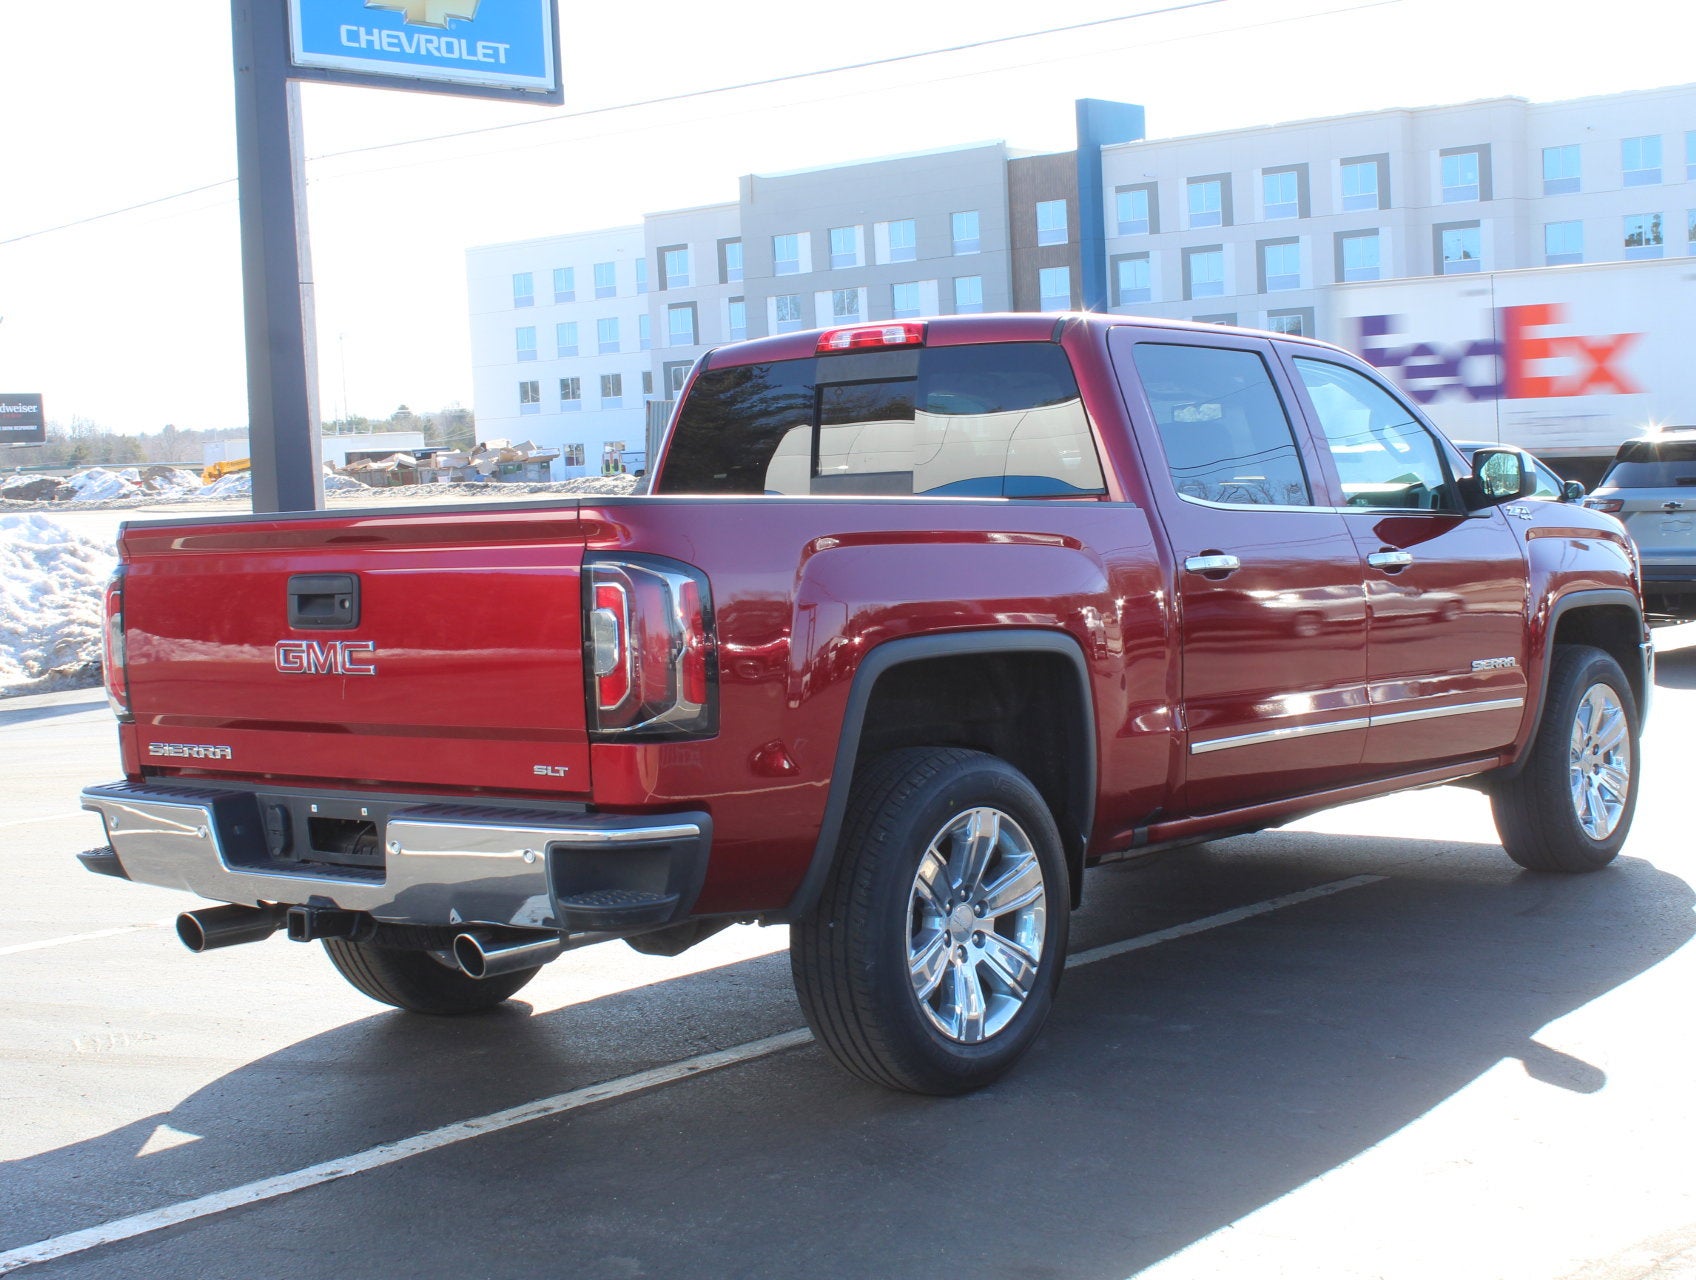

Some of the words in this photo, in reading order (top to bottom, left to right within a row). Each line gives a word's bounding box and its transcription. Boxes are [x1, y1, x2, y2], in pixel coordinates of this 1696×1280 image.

[339, 23, 511, 65] CHEVROLET
[1350, 301, 1647, 404] FedEx
[274, 639, 376, 675] GMC
[1471, 656, 1516, 672] SIERRA
[148, 742, 233, 760] SIERRA
[533, 764, 569, 777] SLT
